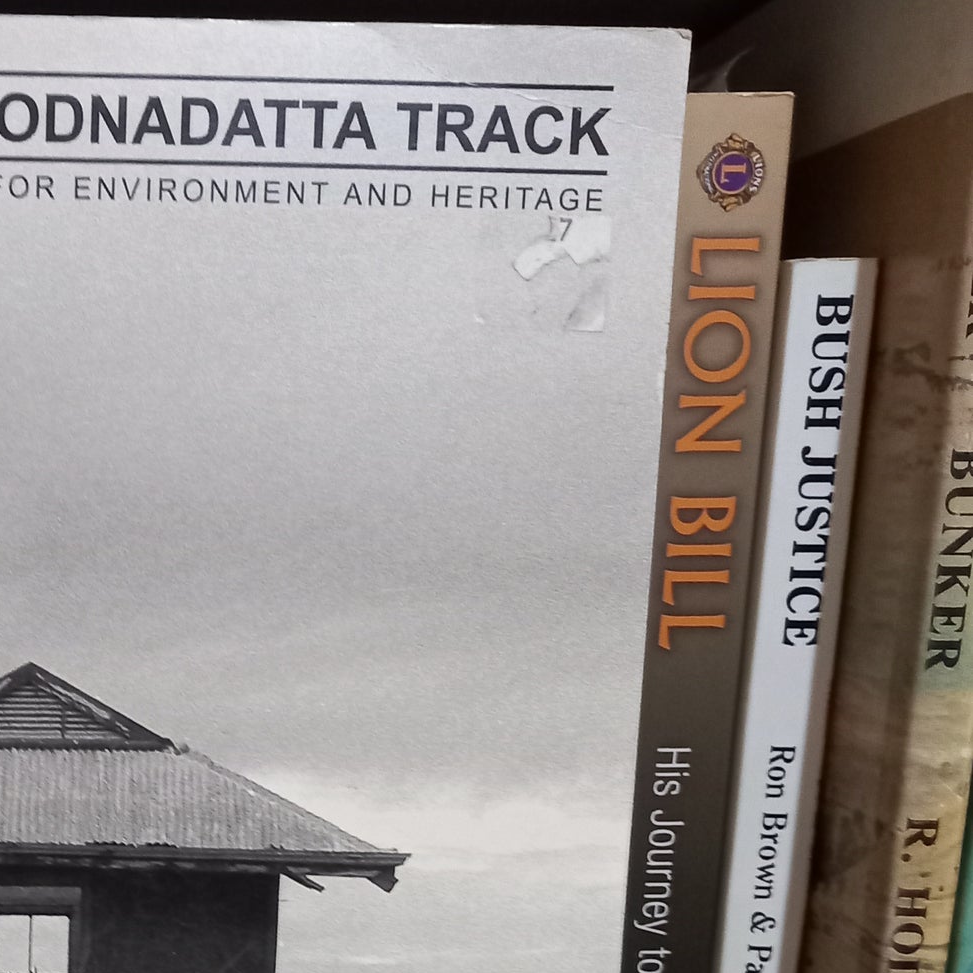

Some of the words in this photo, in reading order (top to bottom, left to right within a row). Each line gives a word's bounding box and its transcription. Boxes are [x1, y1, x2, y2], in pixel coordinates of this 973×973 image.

[396, 101, 611, 156] TRACK
[74, 175, 328, 205] ENVIRONMENT
[343, 183, 412, 207] AND
[431, 185, 603, 212] HERITAGE
[720, 162, 746, 184] L
[749, 151, 764, 193] LIONS
[675, 235, 761, 453] LION
[804, 293, 854, 430] BUSH
[658, 495, 737, 651] BILL
[781, 446, 837, 647] JUSTICE
[925, 448, 973, 671] BUNKER
[653, 747, 692, 796] His
[765, 745, 796, 799] Ron
[754, 812, 787, 900] Brown
[901, 818, 939, 863] R.
[634, 809, 685, 936] Journey
[750, 911, 776, 933] &
